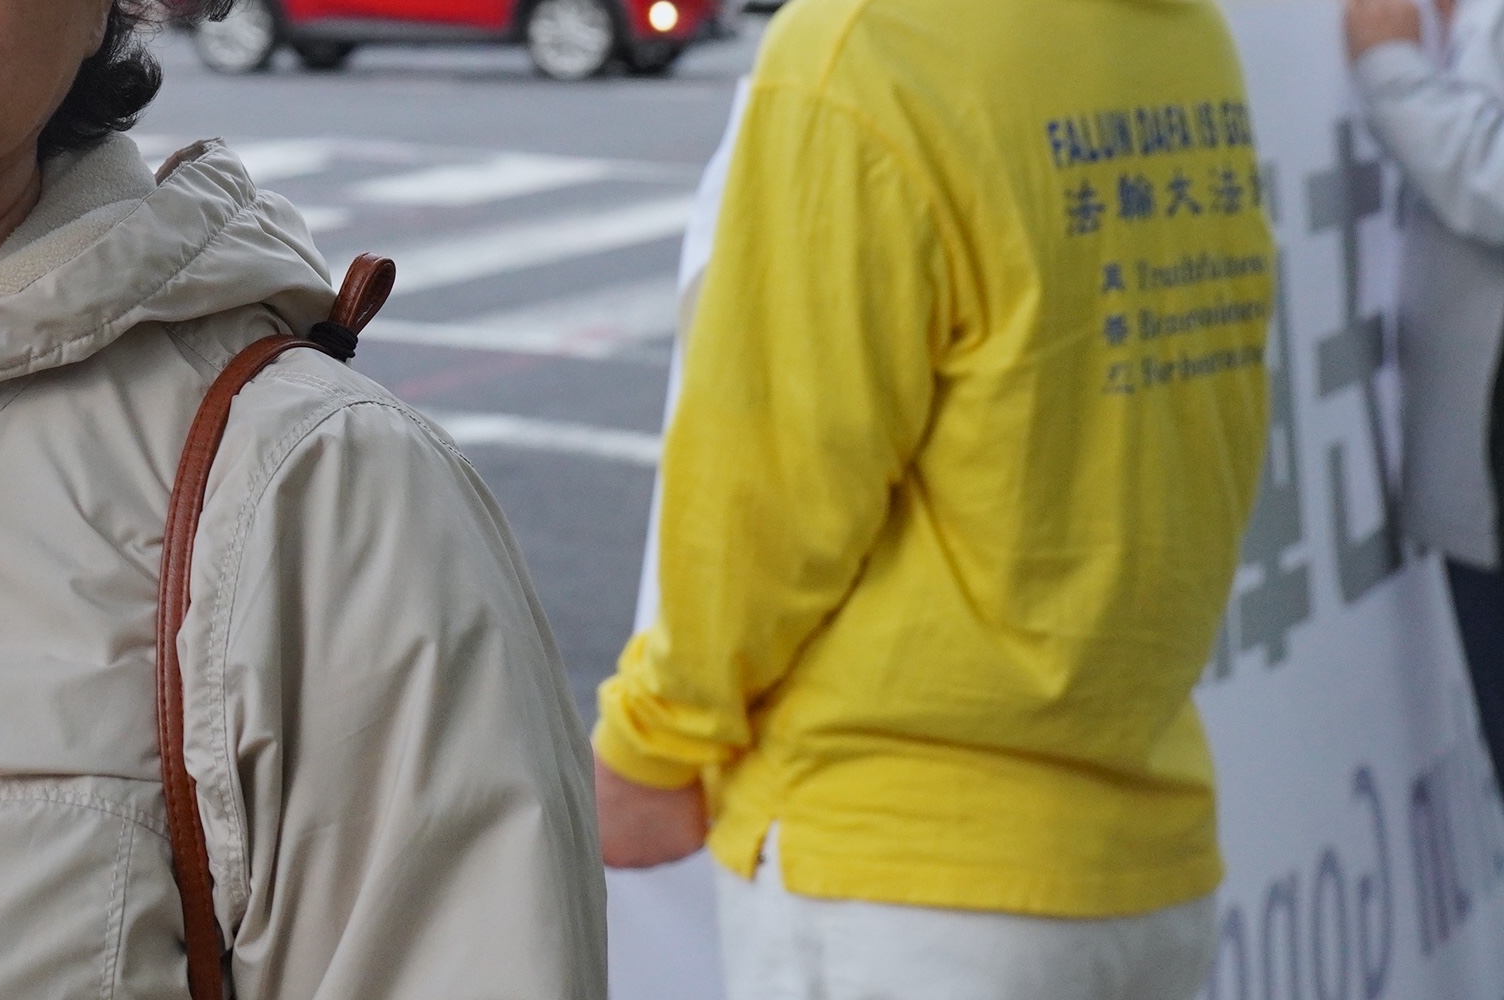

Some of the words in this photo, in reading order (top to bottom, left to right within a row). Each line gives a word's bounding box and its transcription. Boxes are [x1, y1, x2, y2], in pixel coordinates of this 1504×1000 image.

[1047, 111, 1134, 168] FALUN
[1135, 103, 1193, 156] DAFA
[1196, 101, 1219, 149] IS
